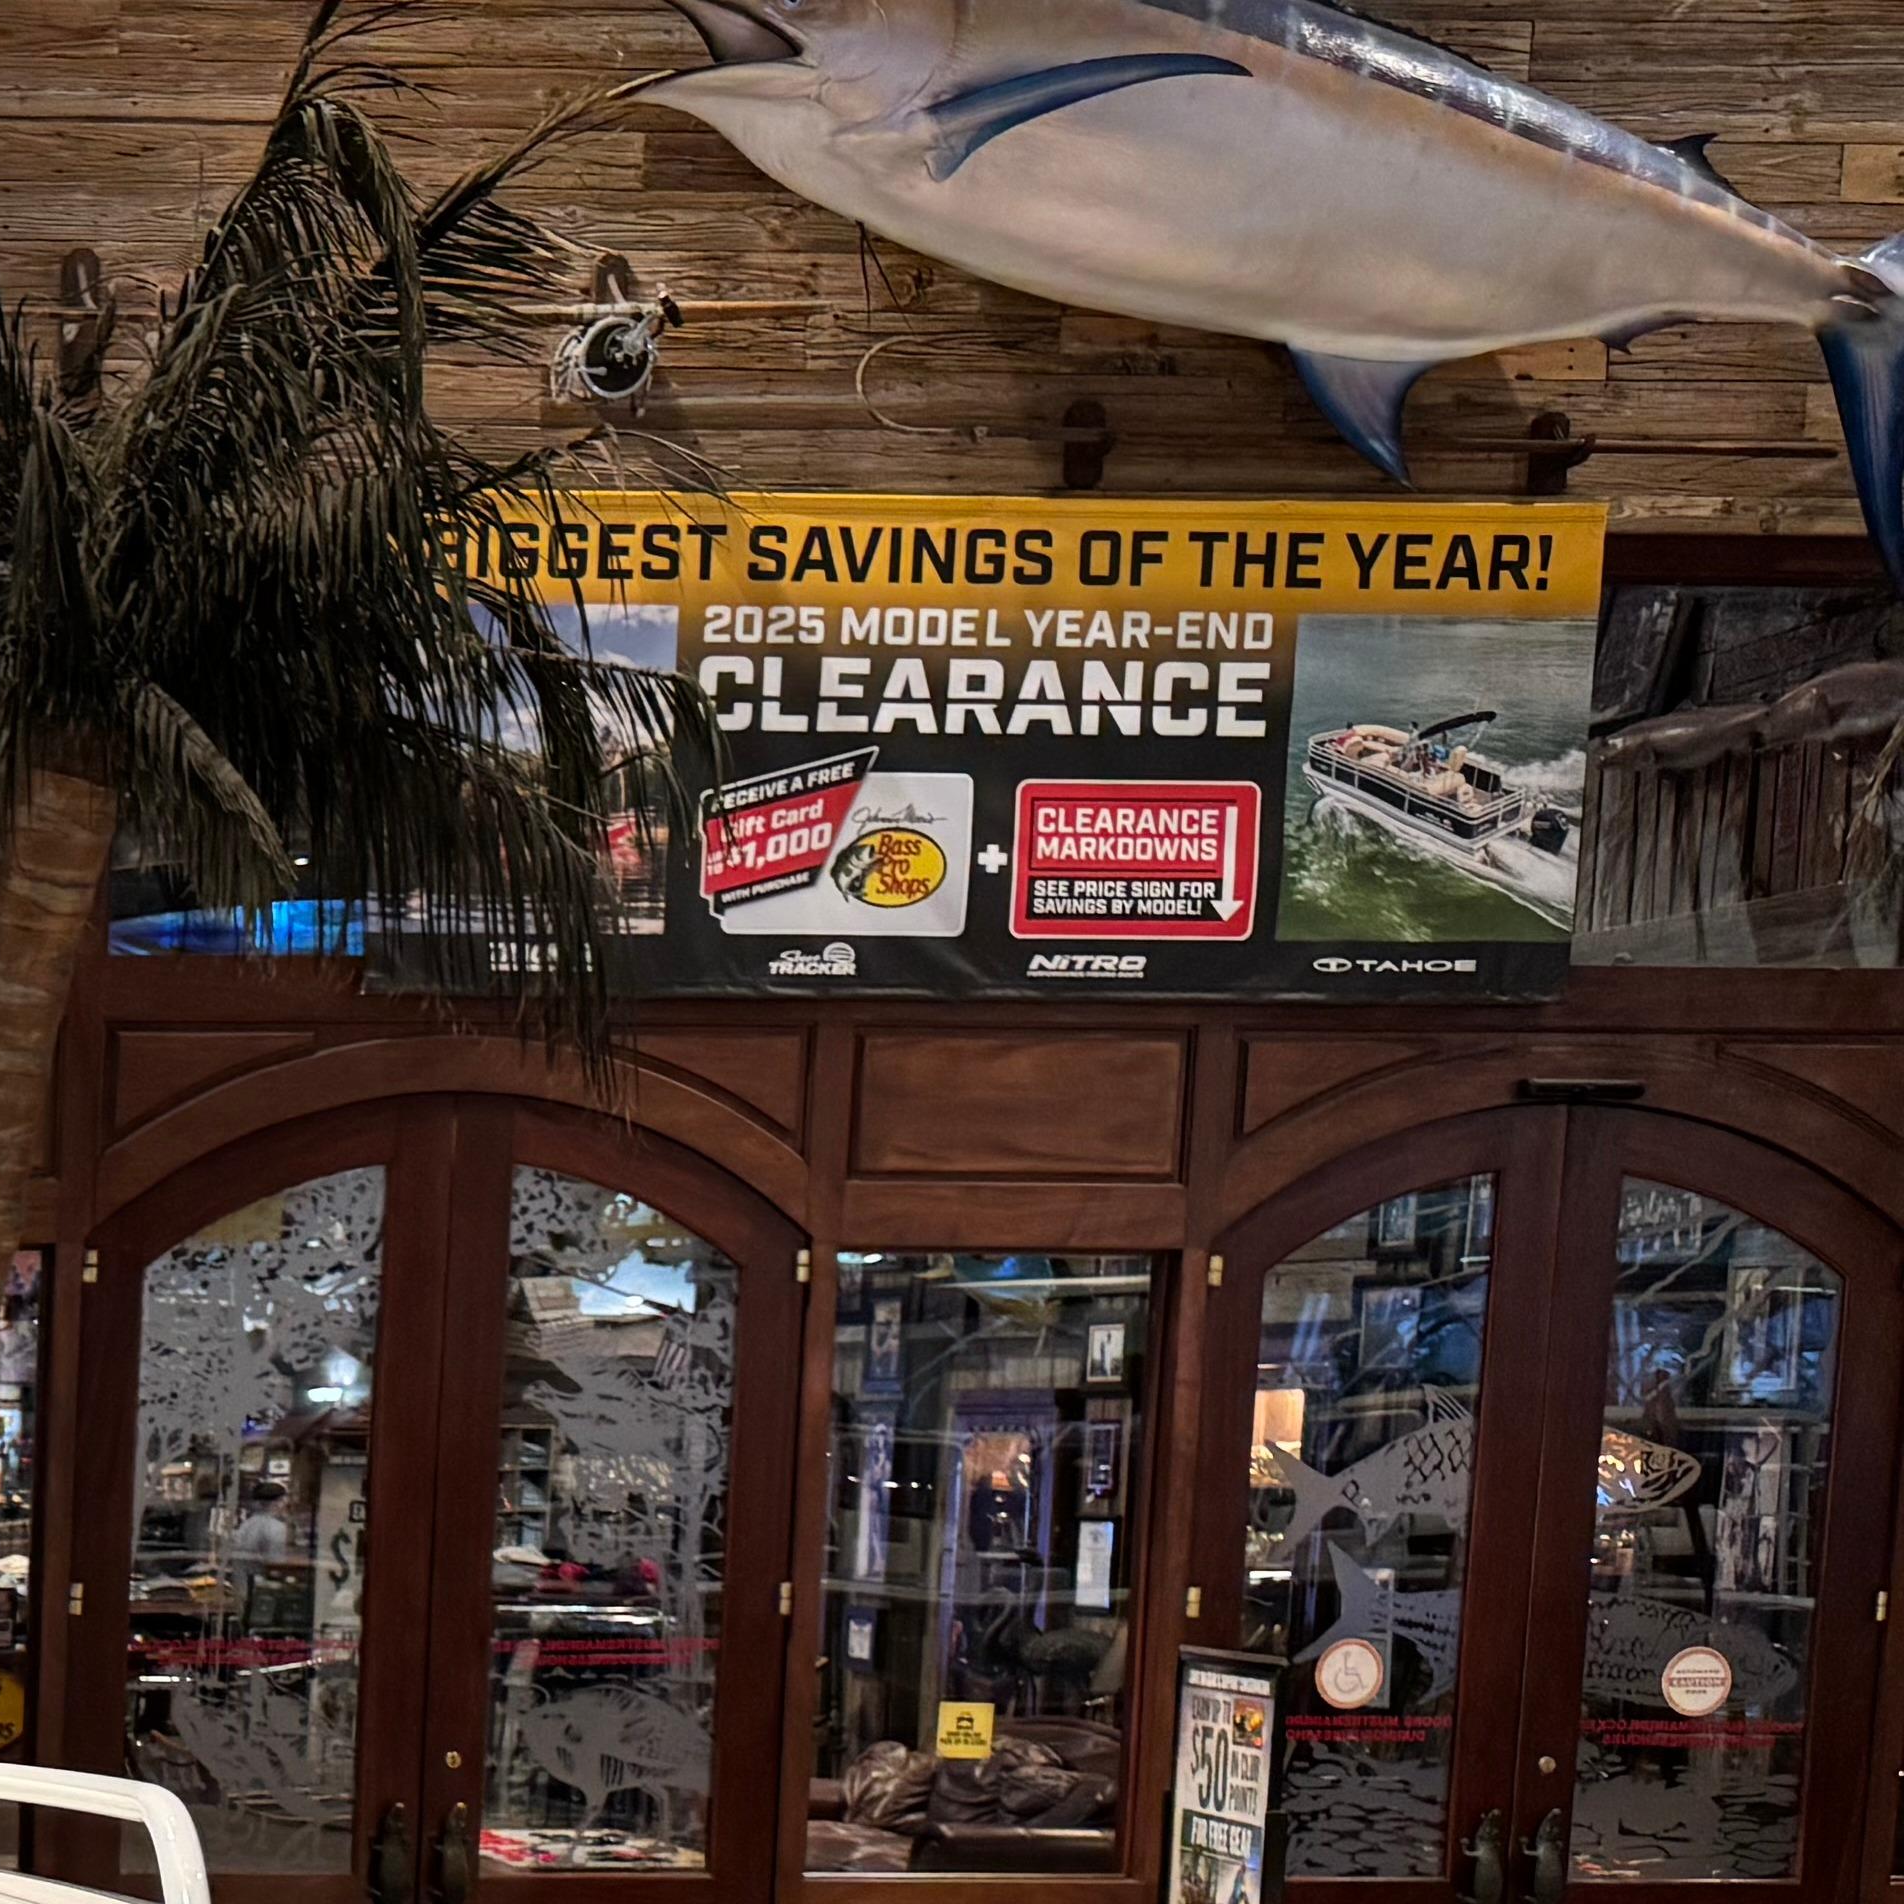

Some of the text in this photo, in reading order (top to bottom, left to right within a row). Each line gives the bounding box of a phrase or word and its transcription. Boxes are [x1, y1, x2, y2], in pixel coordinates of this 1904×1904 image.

[747, 525, 1054, 587] SAVINGS
[1078, 529, 1169, 587] OF
[1188, 531, 1326, 590] THE
[1345, 533, 1554, 592] YEAR!
[703, 604, 1274, 651] 2025 MODEL YEAR-END
[699, 654, 1272, 738] CLEARANCE
[790, 775, 804, 792] A
[807, 761, 856, 788] FREE
[771, 798, 825, 830] Card
[1036, 807, 1220, 836] CLEARANCE
[876, 833, 923, 856] Bass
[1036, 835, 1218, 862] MARKDOWNS
[1033, 879, 1216, 899] SEE PRICE SIGN FOR
[1033, 898, 1203, 916] SAVINGS BY MODEL!
[768, 961, 857, 976] TRACKER
[1356, 958, 1477, 973] TAHOE
[1190, 1723, 1230, 1813] $50
